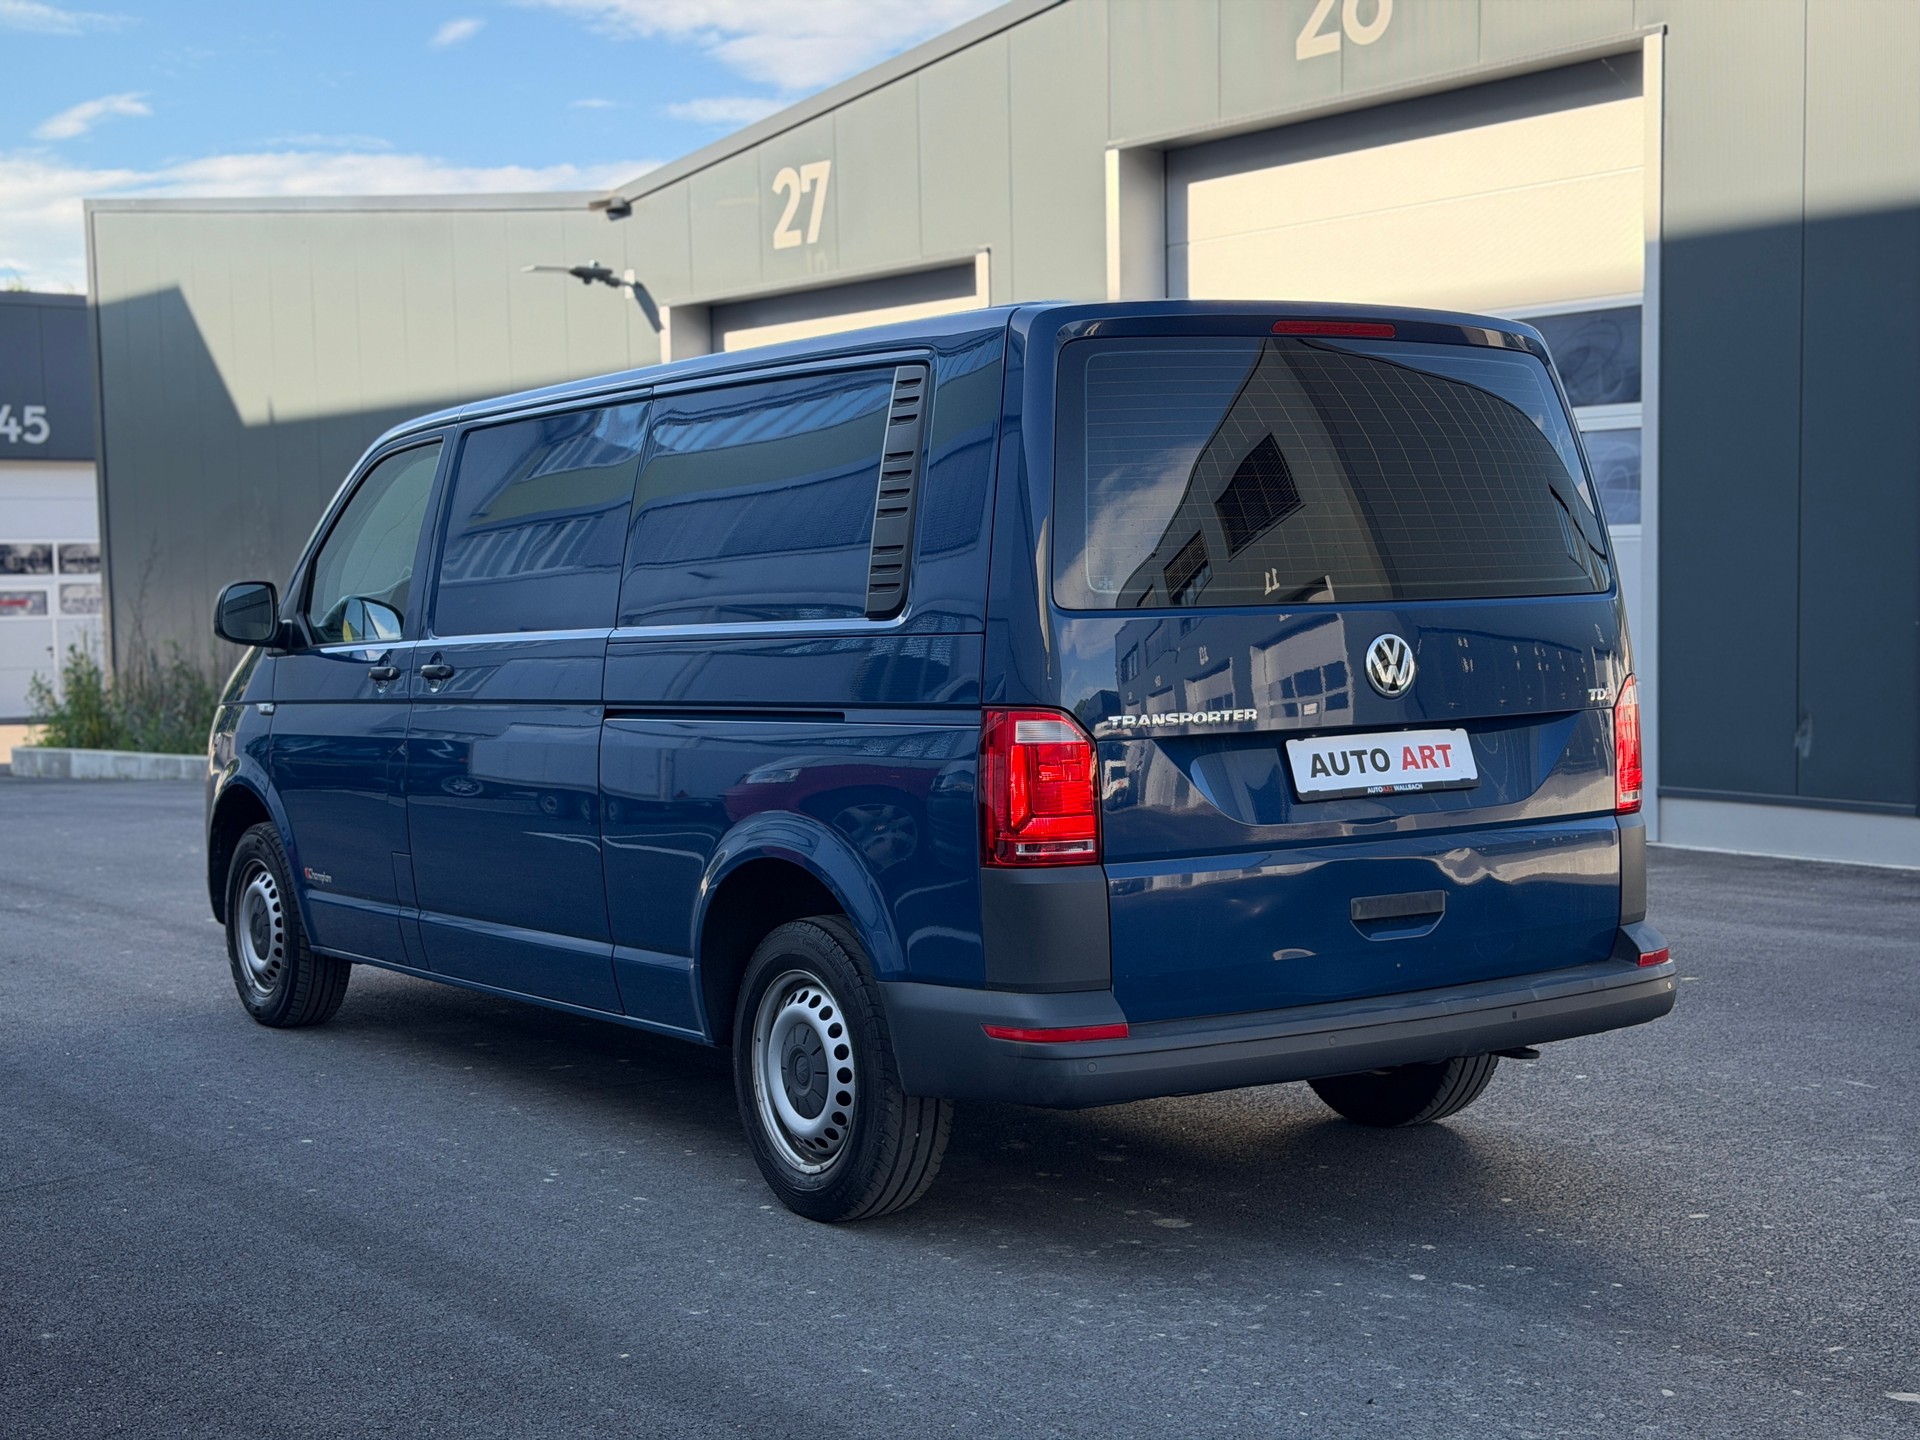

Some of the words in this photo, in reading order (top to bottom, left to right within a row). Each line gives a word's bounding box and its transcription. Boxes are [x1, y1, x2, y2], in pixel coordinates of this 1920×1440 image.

[772, 160, 831, 249] 27
[0, 404, 50, 444] 45
[1108, 708, 1258, 730] TRANSPORTER
[1310, 748, 1391, 779] AUTO
[1402, 744, 1452, 771] ART
